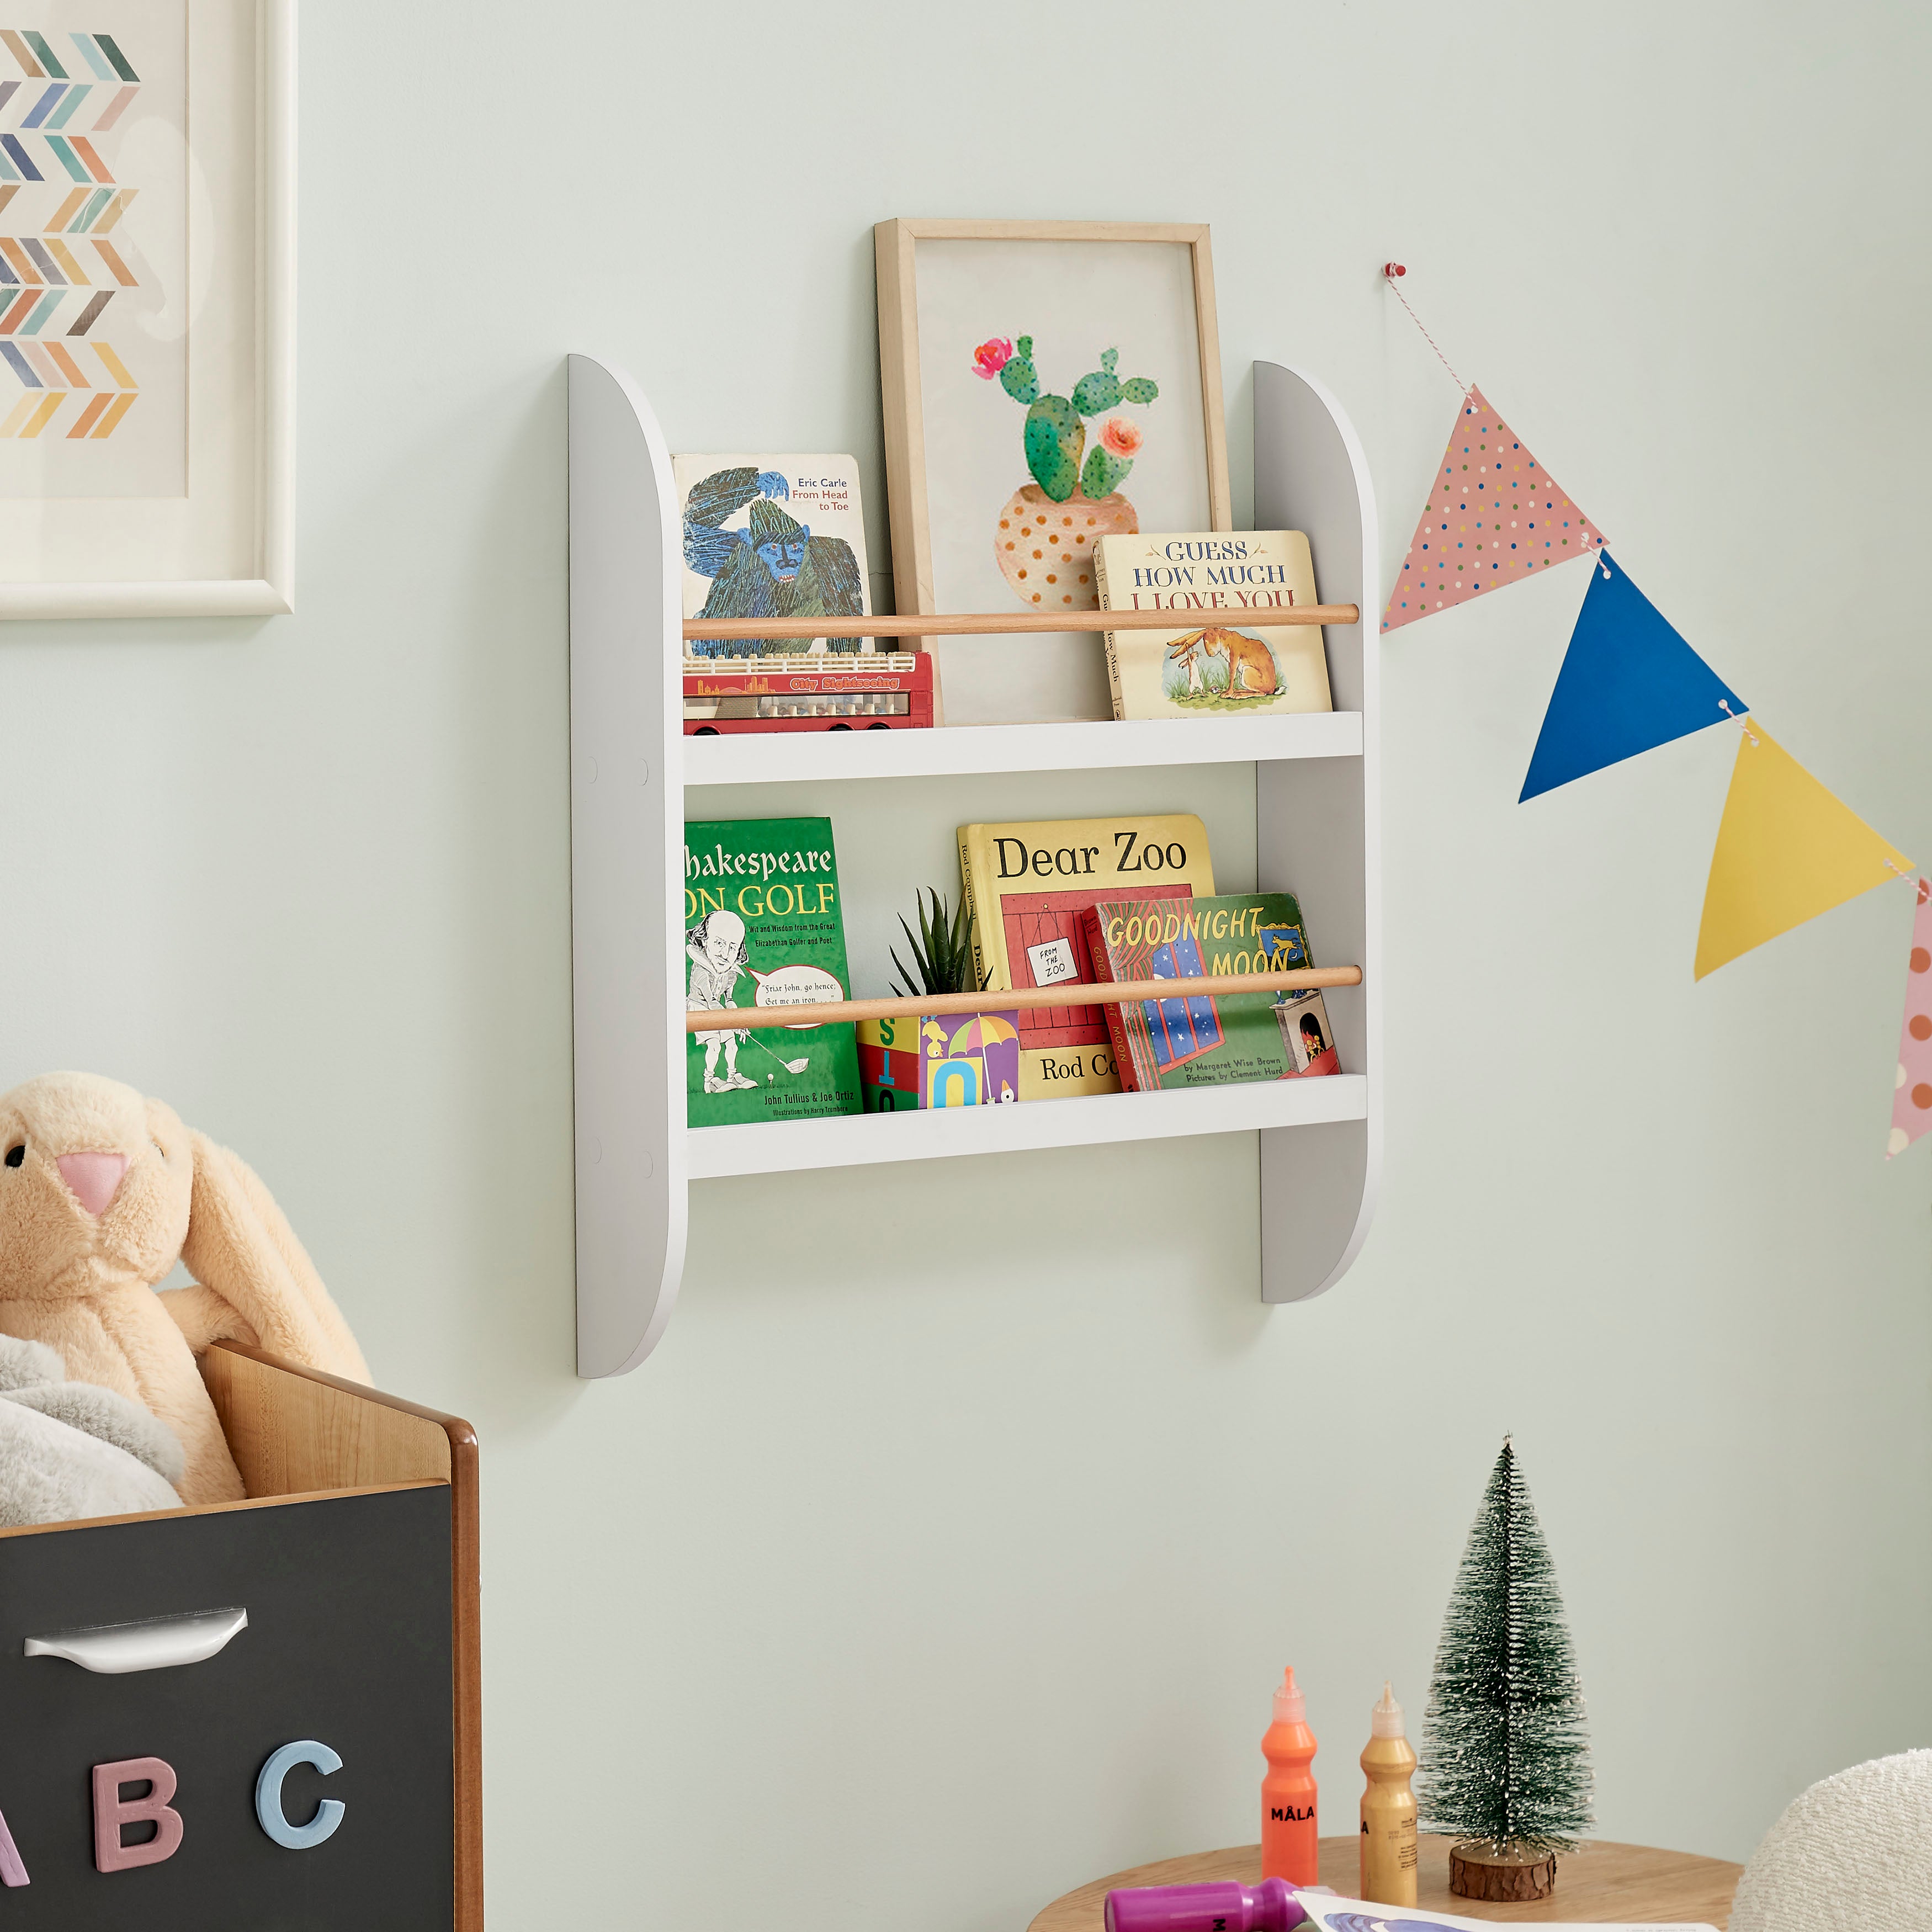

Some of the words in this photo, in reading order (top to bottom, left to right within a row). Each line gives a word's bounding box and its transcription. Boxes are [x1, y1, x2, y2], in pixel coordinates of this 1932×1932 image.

[798, 478, 818, 487] Eric
[820, 478, 847, 487] Carle
[792, 490, 819, 499] From
[822, 490, 848, 499] Head
[831, 502, 849, 511] Toe
[1165, 540, 1248, 561] GUESS
[1133, 566, 1196, 588] HOW
[1207, 565, 1287, 586] MUCH
[1153, 592, 1228, 610] LOVE
[1234, 590, 1294, 608] YOU
[1111, 654, 1119, 682] Much
[790, 677, 818, 692] City
[822, 676, 900, 691] Sightseeing
[684, 843, 832, 882] hakespeare
[993, 837, 1100, 879] Dear
[1114, 831, 1187, 873] Zoo
[737, 883, 835, 917] GOLF
[965, 868, 976, 920] Campbll
[1107, 906, 1265, 948] GOODNIGHT
[755, 939, 788, 947] Elizabethan
[1039, 947, 1057, 959] FROM
[973, 943, 983, 985] Dear
[1046, 955, 1058, 965] THE
[1212, 948, 1291, 976] MOON
[1045, 963, 1065, 978] ZOO
[804, 984, 813, 992] go
[1094, 947, 1118, 1019] GOODHT
[1112, 1026, 1128, 1063] MOON
[1039, 1055, 1085, 1080] Rod
[1183, 1064, 1193, 1073] by
[1196, 1061, 1232, 1071] Margaret
[1233, 1059, 1254, 1068] Wise
[1256, 1057, 1281, 1066] Brown
[1186, 1074, 1216, 1082] Pictures
[1218, 1072, 1228, 1081] by
[1230, 1069, 1261, 1079] Clement
[1264, 1066, 1283, 1075] Hurd
[765, 1095, 782, 1106] John
[784, 1094, 810, 1104] Tullius
[812, 1092, 818, 1102] &
[820, 1092, 833, 1102] Joe
[835, 1090, 854, 1101] Ortiz
[92, 1756, 184, 1873] B
[256, 1739, 346, 1850] C
[1271, 1806, 1314, 1822] MÅLA
